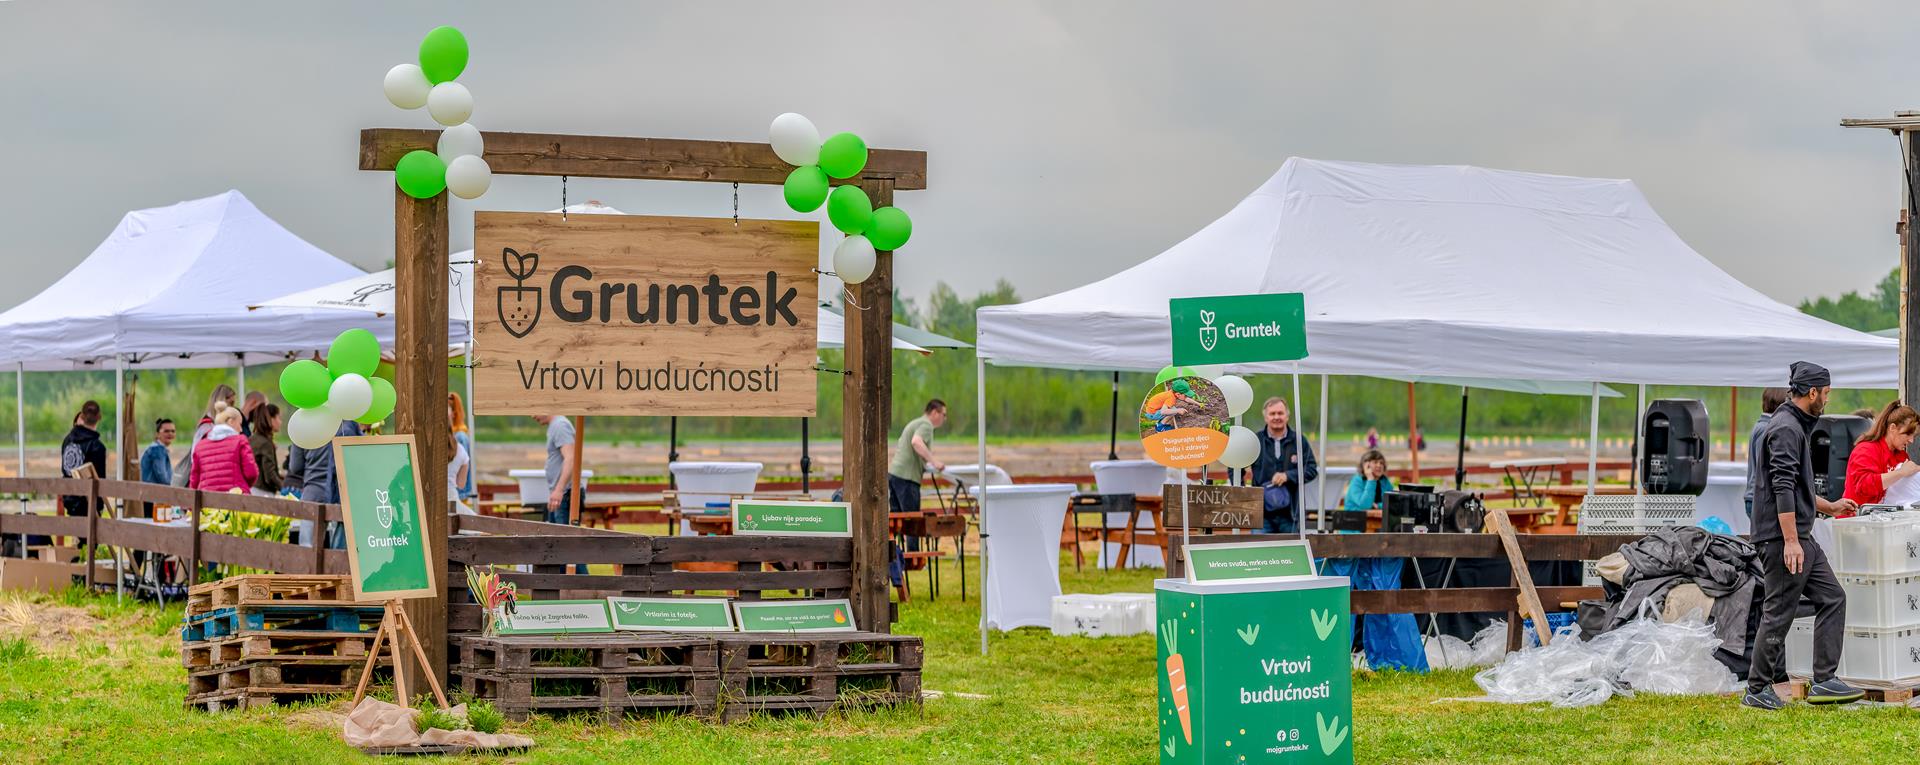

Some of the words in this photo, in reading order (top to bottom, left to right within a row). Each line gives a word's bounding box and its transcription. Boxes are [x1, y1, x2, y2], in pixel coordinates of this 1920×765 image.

[550, 265, 798, 326] Gruntek
[1225, 321, 1281, 339] Gruntek
[517, 359, 603, 390] Vrtovi
[616, 361, 779, 391] budućnosti
[1162, 436, 1194, 444] Osigurajte
[1186, 489, 1230, 505] IKNIK
[762, 514, 782, 523] Ljubav
[783, 514, 794, 523] nije
[1211, 511, 1251, 526] ZONA
[367, 533, 409, 548] Gruntek
[1249, 559, 1268, 567] mrkva
[541, 614, 547, 622] je
[548, 613, 572, 621] Zagrebu
[1261, 655, 1311, 676] Vrtovi
[1240, 680, 1330, 704] budućnosti
[1266, 743, 1309, 754] mojgruntek.hr
